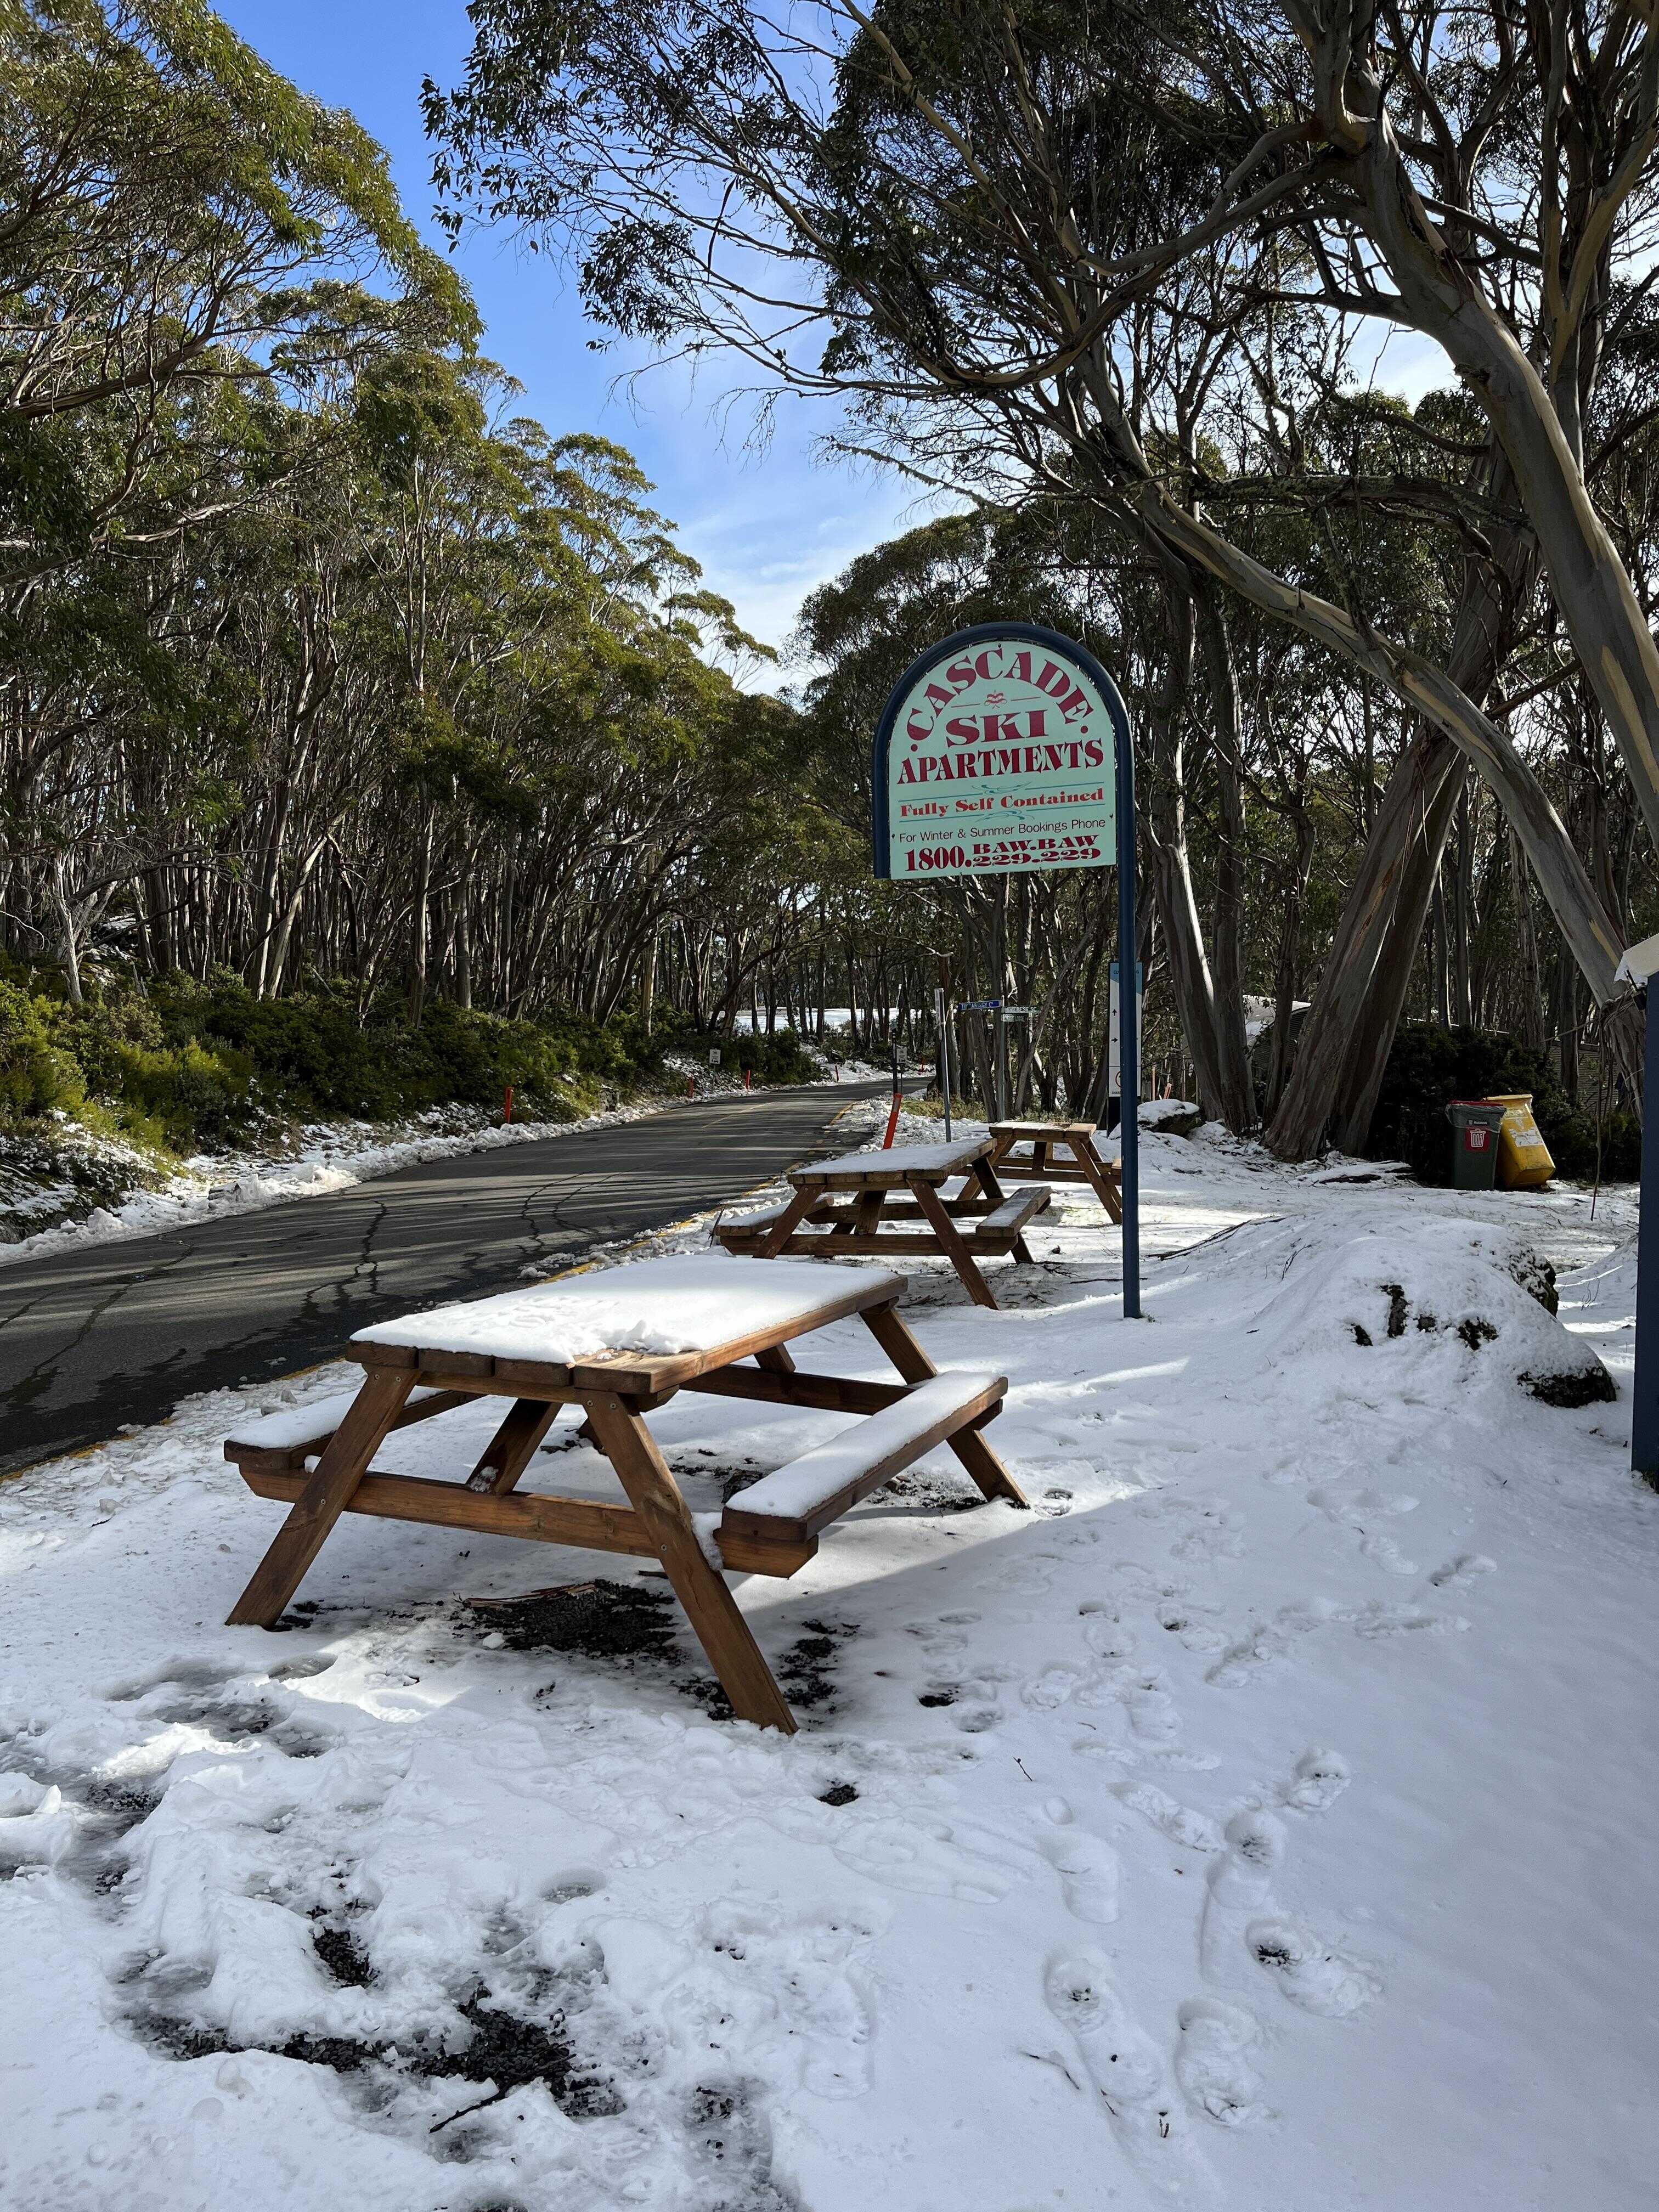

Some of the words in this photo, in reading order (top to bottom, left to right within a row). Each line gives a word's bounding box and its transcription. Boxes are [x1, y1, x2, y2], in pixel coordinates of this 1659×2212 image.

[907, 647, 1094, 741] CASCADE
[946, 709, 1050, 748] SKI
[896, 737, 1104, 785] APARTMENTS
[900, 802, 949, 817] Fully
[956, 797, 995, 813] Self
[1001, 788, 1104, 809] Contained
[900, 833, 916, 843] For
[920, 831, 953, 842] Winter
[957, 828, 966, 838] &
[970, 825, 1014, 837] Summer
[1019, 822, 1068, 833] Bookings
[1071, 819, 1106, 830] Phone
[973, 848, 1101, 867] 229.229
